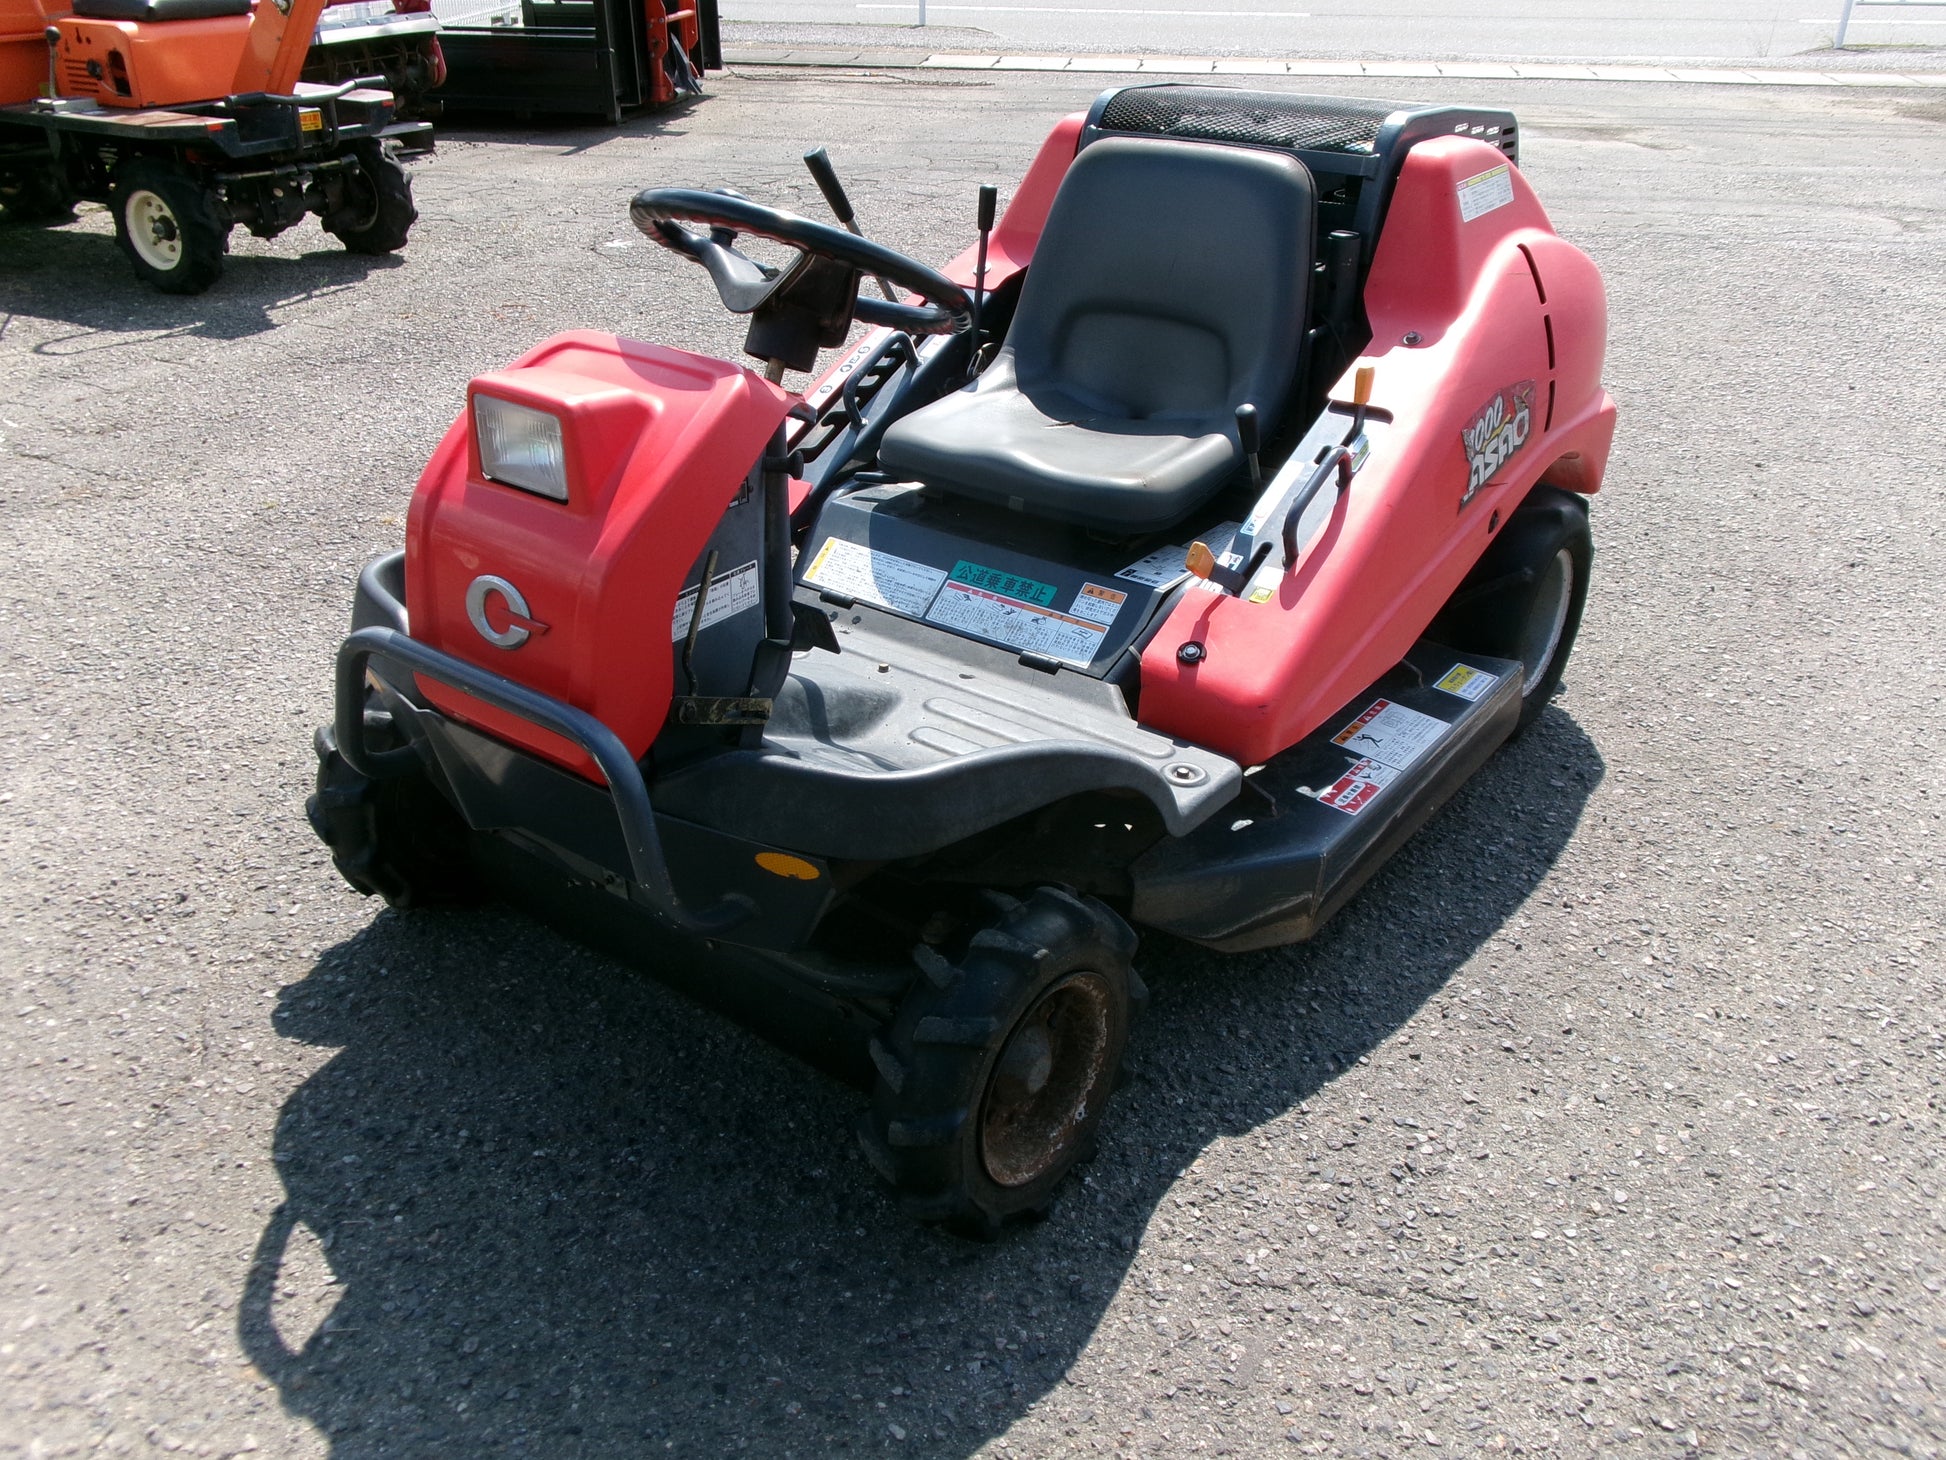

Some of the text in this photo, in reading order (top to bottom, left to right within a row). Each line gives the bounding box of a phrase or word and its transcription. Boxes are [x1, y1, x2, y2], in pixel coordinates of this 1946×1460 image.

[1463, 410, 1529, 501] ASAO
[957, 563, 1050, 604] 公道乗車禁止
